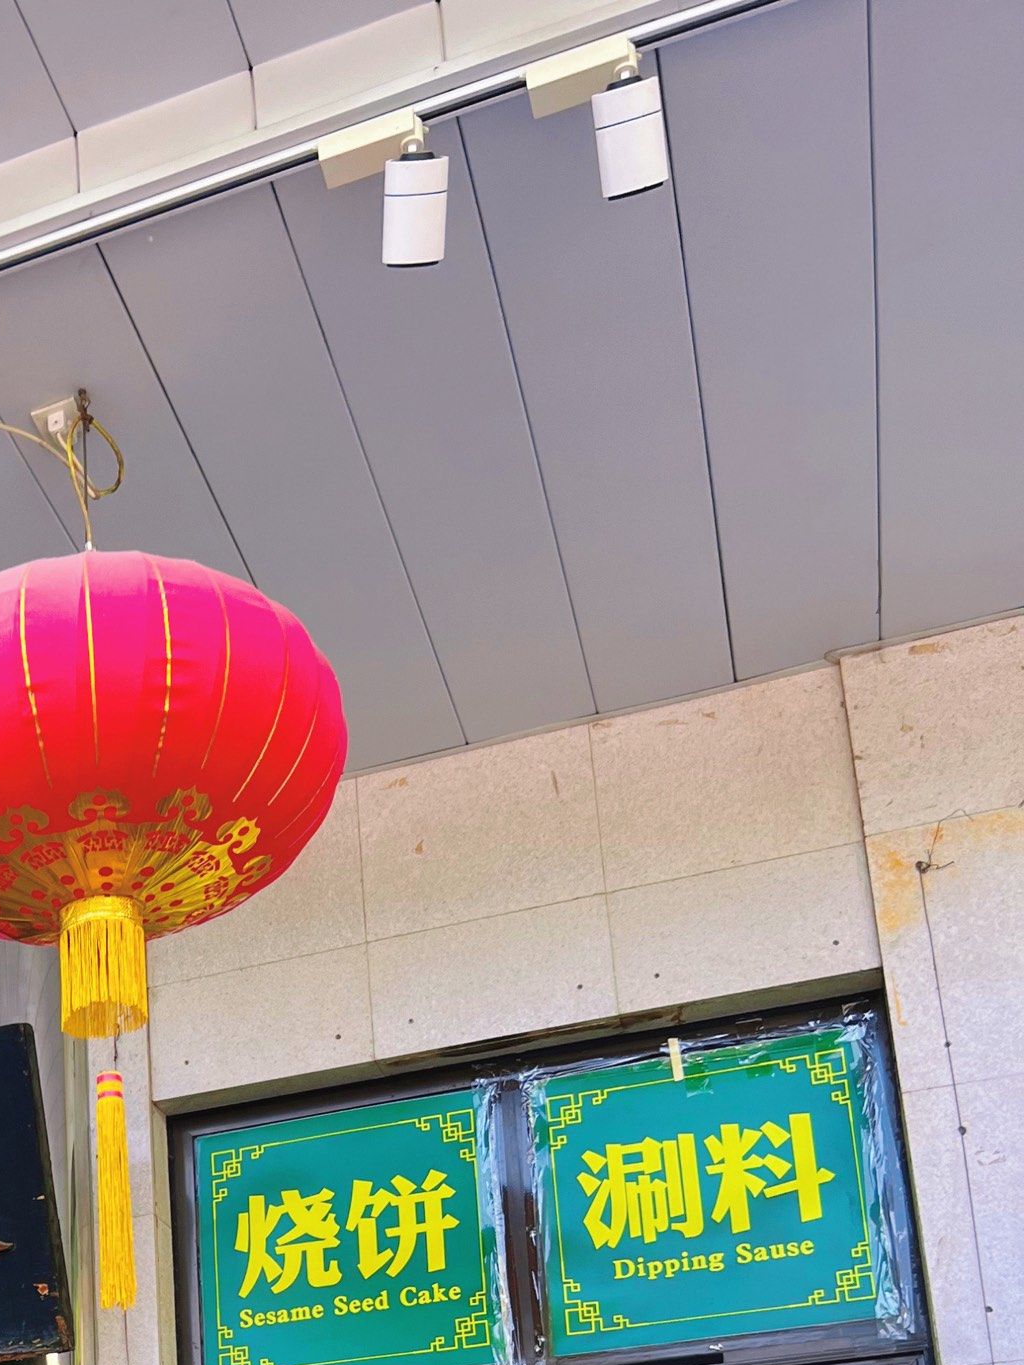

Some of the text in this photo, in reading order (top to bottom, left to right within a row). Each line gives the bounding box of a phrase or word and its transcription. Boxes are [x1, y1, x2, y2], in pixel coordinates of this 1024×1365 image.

[578, 1112, 836, 1251] 涮料
[234, 1169, 460, 1297] 烧饼
[614, 1236, 815, 1284] Dipping Sause
[238, 1280, 462, 1330] Sesame Seed Cake
